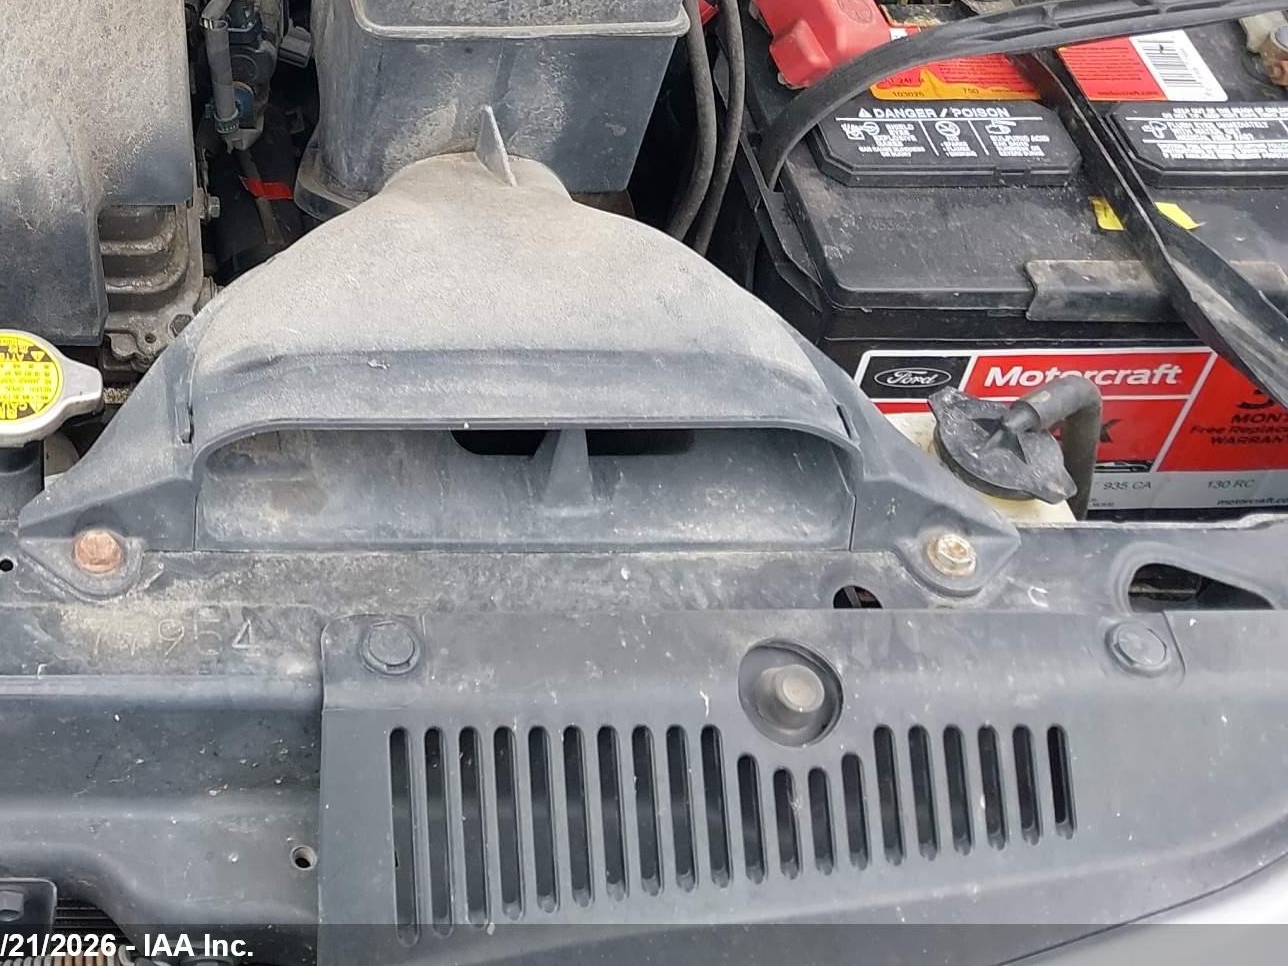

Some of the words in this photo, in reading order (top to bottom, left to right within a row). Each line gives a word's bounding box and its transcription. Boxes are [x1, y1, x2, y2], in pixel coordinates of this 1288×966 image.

[873, 108, 937, 119] DANGER
[951, 107, 1011, 118] POISON
[887, 370, 939, 384] Ford
[983, 363, 1182, 387] Motrcraft
[1103, 481, 1130, 491] 935
[1132, 481, 1152, 490] CA
[1207, 480, 1232, 489] 130
[1232, 479, 1255, 488] RC
